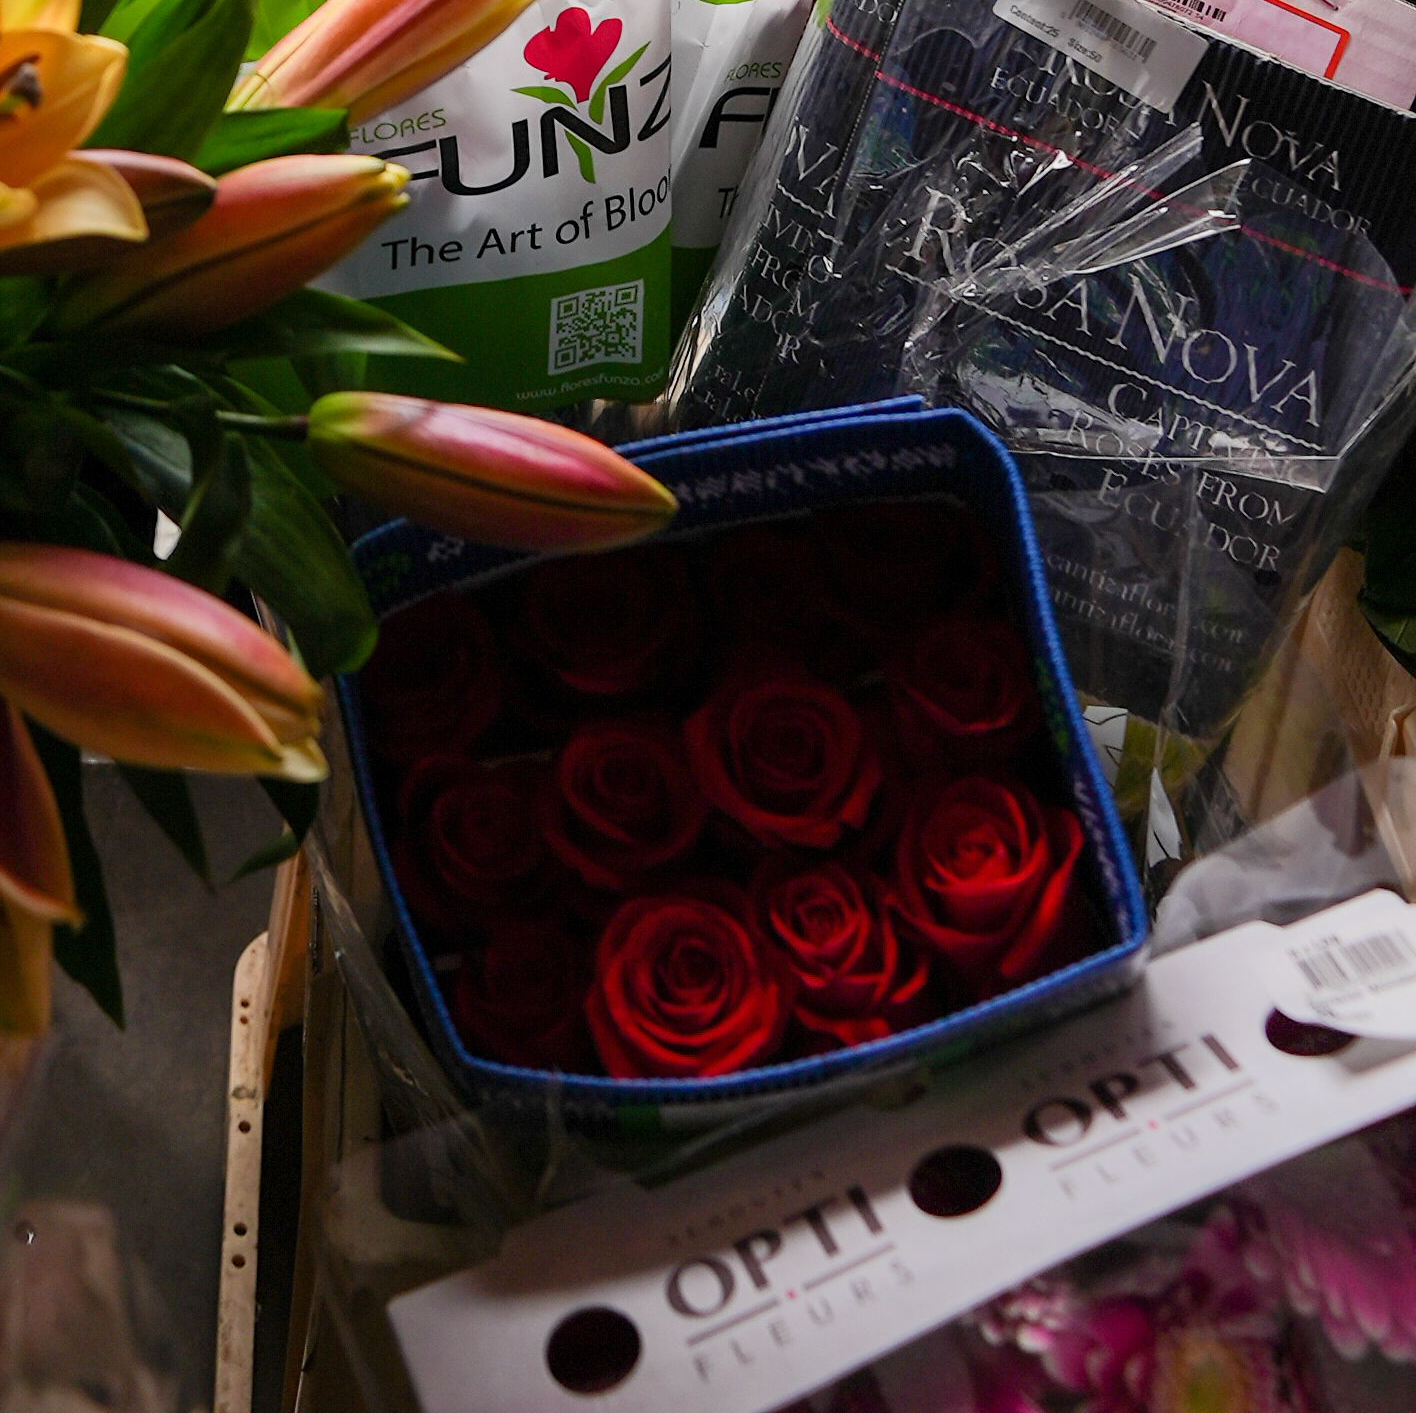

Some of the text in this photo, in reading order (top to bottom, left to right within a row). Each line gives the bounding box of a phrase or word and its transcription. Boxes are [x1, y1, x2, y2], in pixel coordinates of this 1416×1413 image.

[349, 108, 446, 145] FLORES
[1196, 79, 1342, 191] NOVA
[381, 165, 672, 271] The Art of Bloo
[1097, 465, 1282, 572] ECUDOR
[1022, 1032, 1241, 1147] OPTI
[1058, 1091, 1279, 1202] FLEURS
[664, 1183, 884, 1320] OPTI
[693, 1255, 915, 1385] FLEURS
